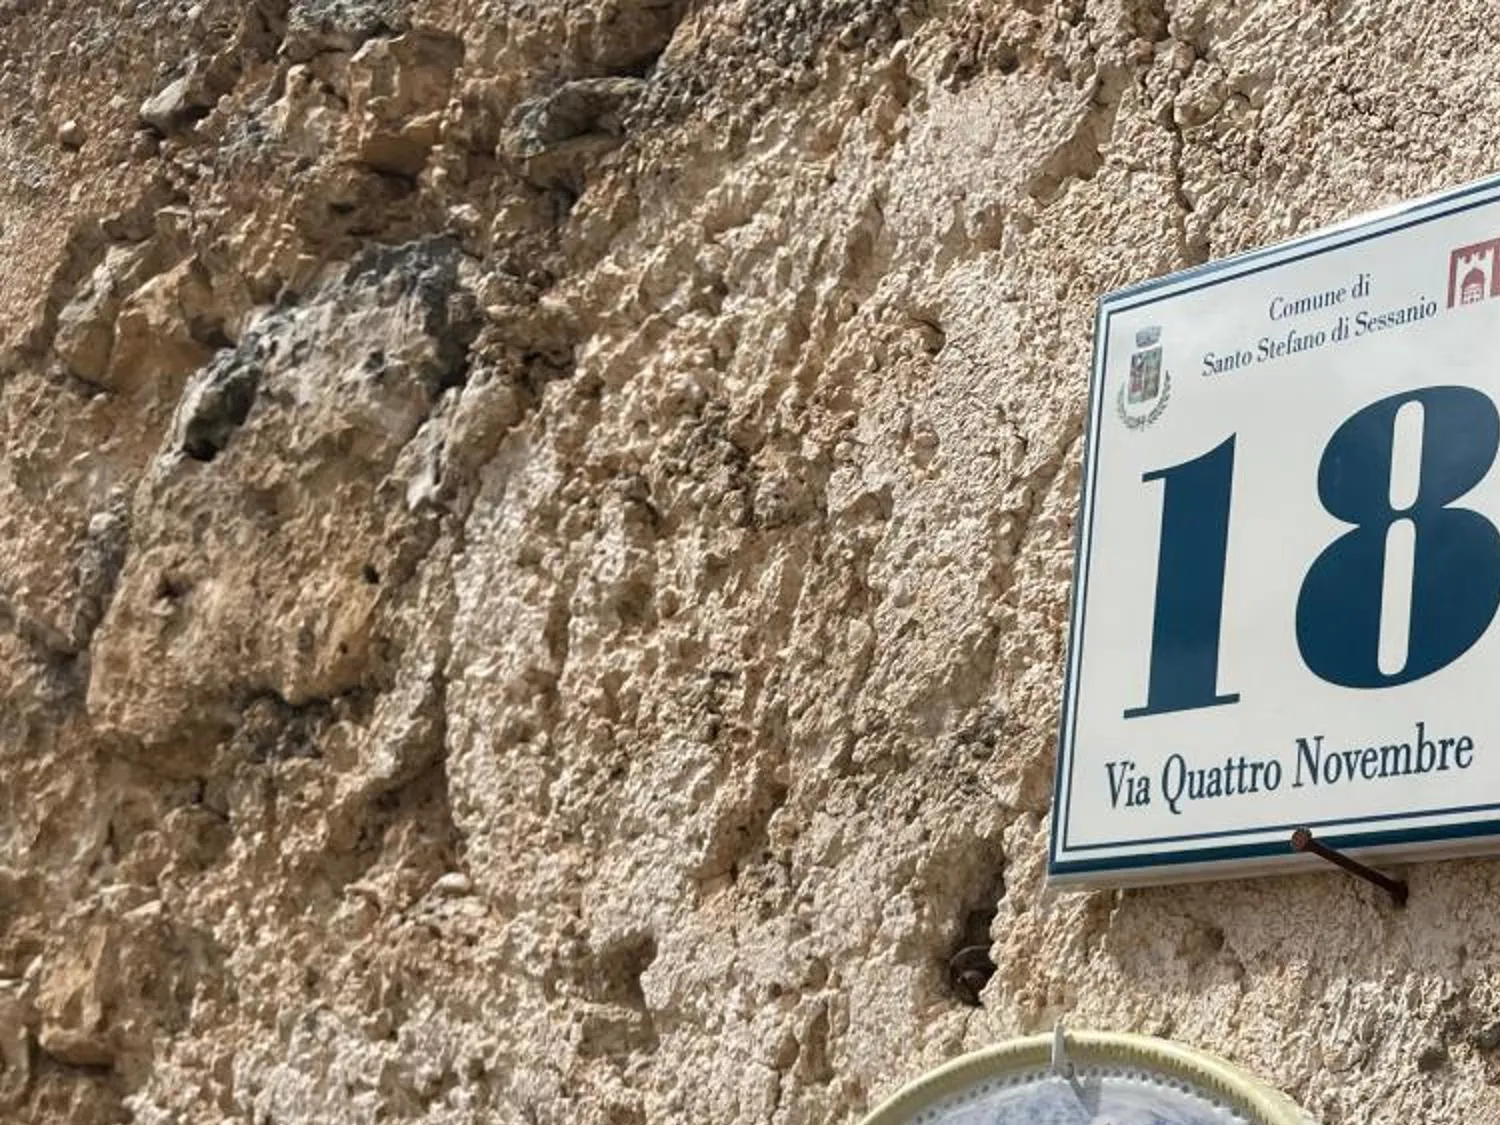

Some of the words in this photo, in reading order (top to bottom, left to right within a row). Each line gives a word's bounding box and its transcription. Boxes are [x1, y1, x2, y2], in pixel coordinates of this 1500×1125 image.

[1201, 349, 1253, 377] Santo
[1256, 330, 1326, 363] Stefano
[1330, 317, 1350, 342] di
[1354, 296, 1438, 337] Sessanio
[1268, 286, 1347, 321] Comune
[1351, 273, 1372, 299] di
[1105, 761, 1151, 809] Via
[1161, 753, 1282, 815] Quattro
[1291, 722, 1474, 788] Novembre
